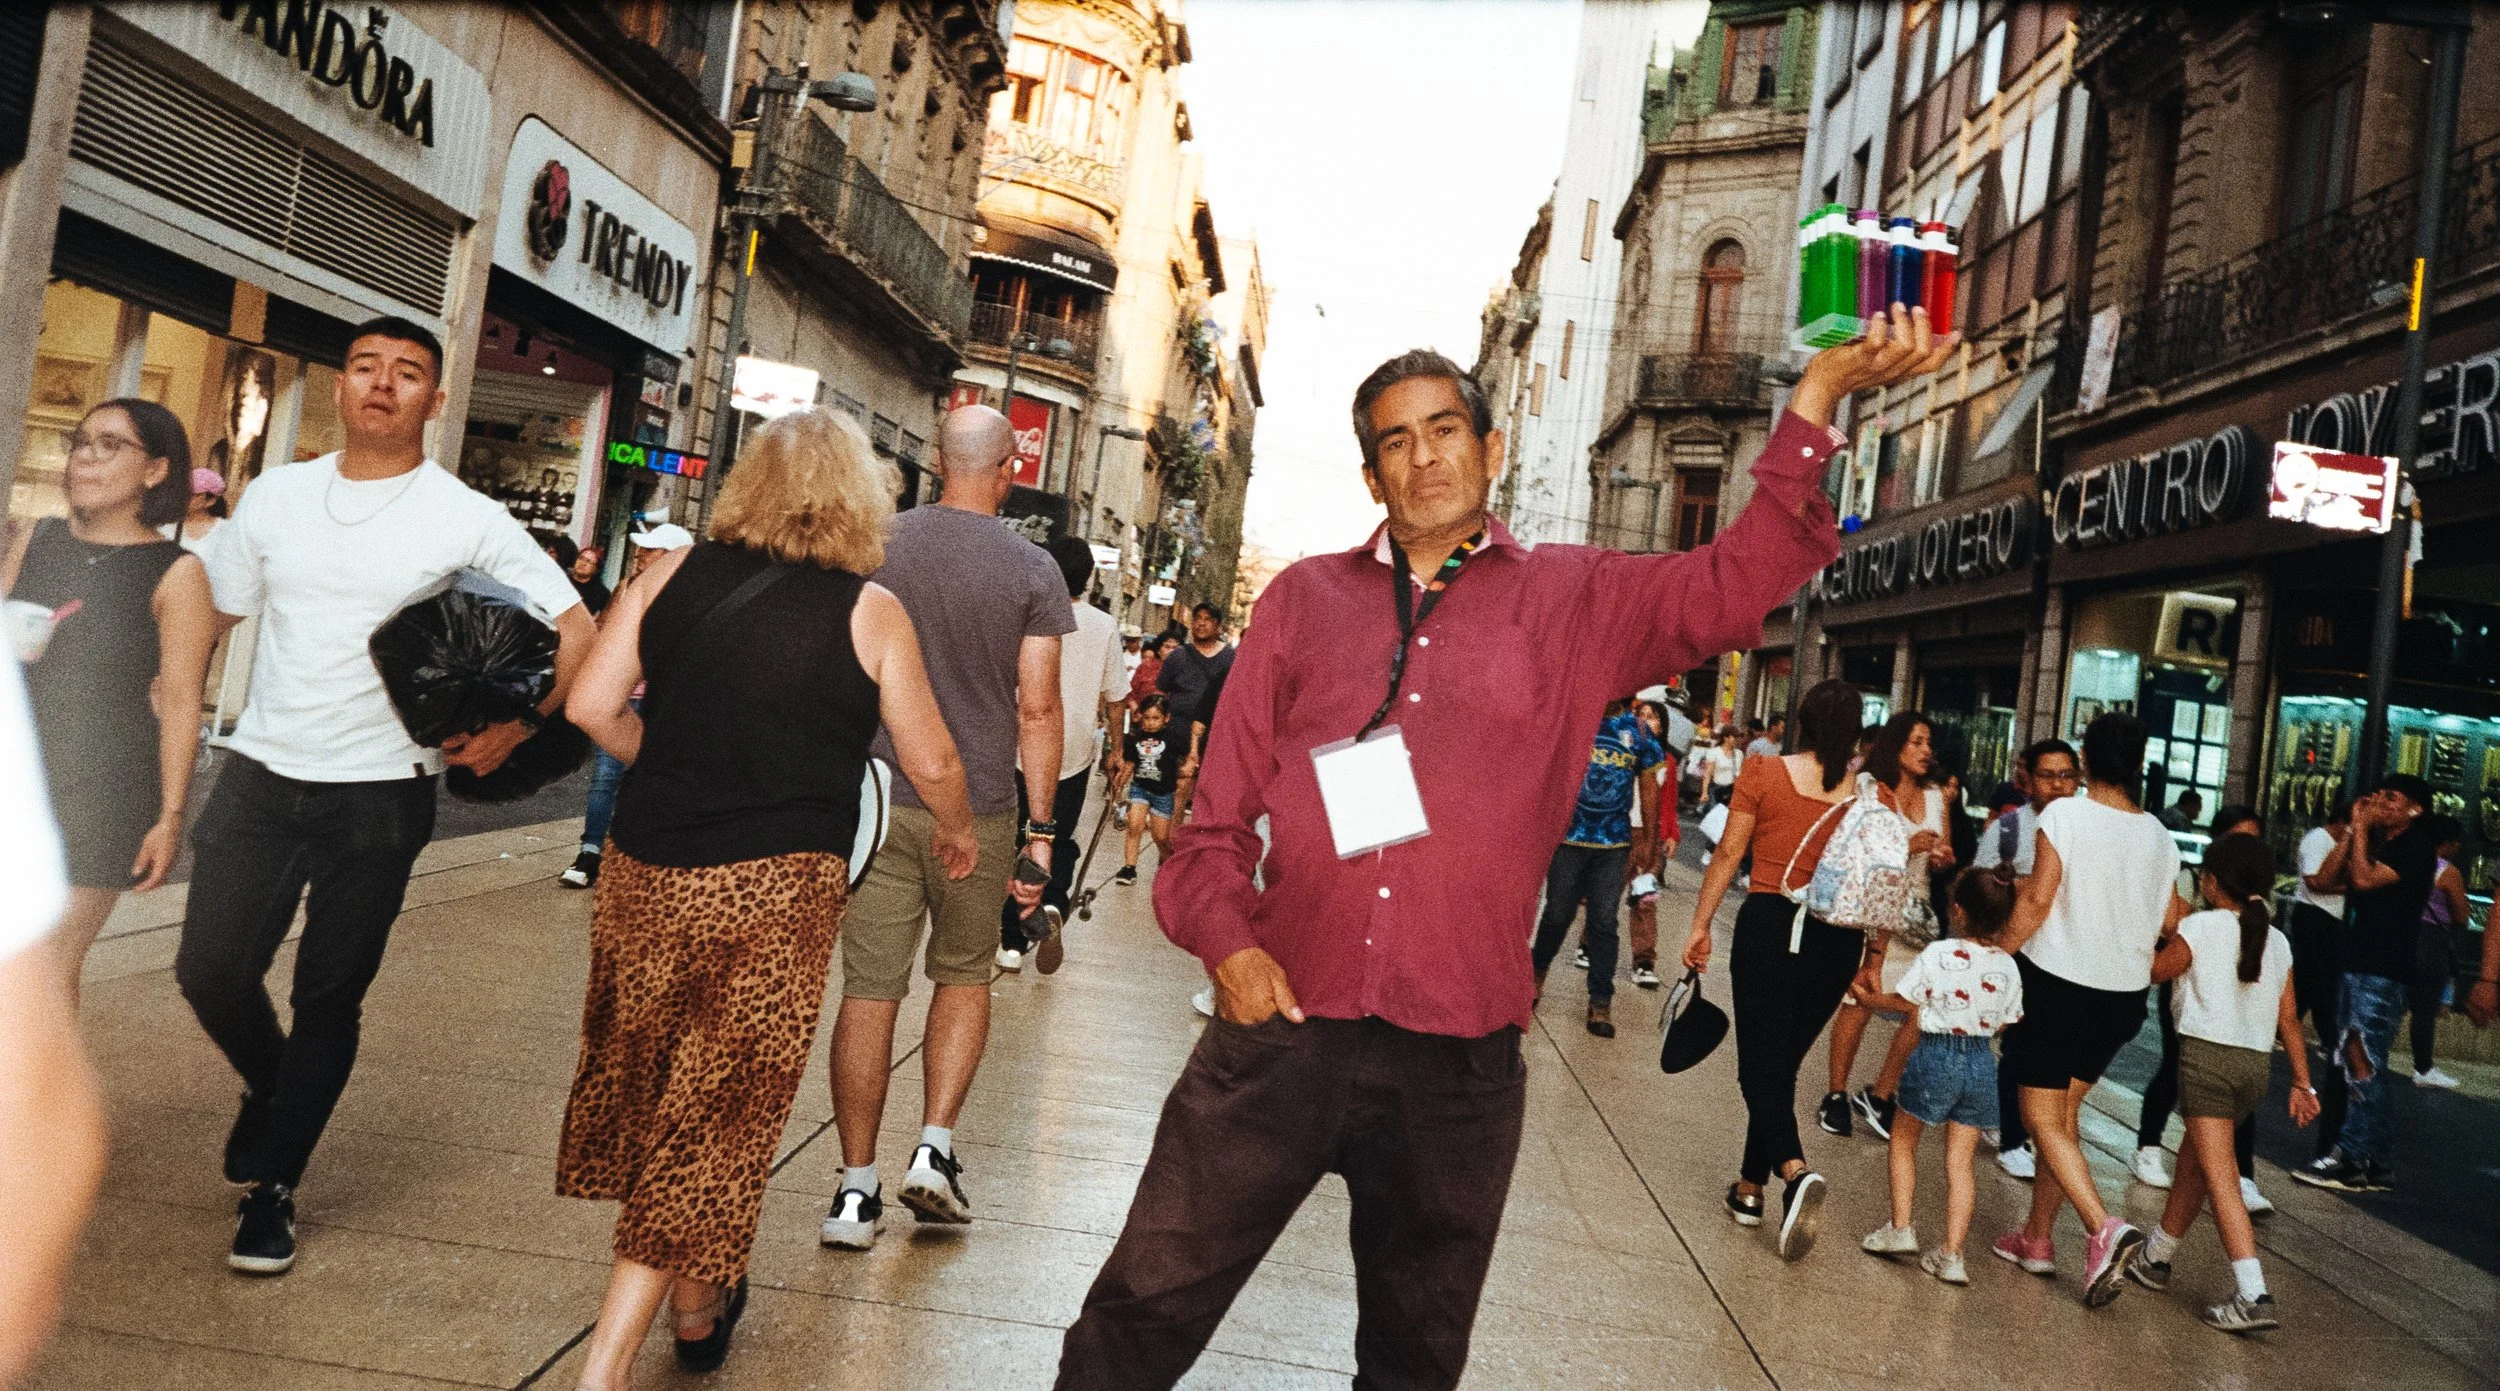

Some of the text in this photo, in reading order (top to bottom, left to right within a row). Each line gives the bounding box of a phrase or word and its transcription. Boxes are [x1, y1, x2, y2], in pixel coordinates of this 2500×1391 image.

[219, 0, 434, 148] ANDORA
[580, 199, 692, 316] TRENDY
[648, 450, 709, 479] LENT
[2053, 428, 2240, 543] CENTRO
[1812, 501, 2016, 602] CENTRO JOYERO
